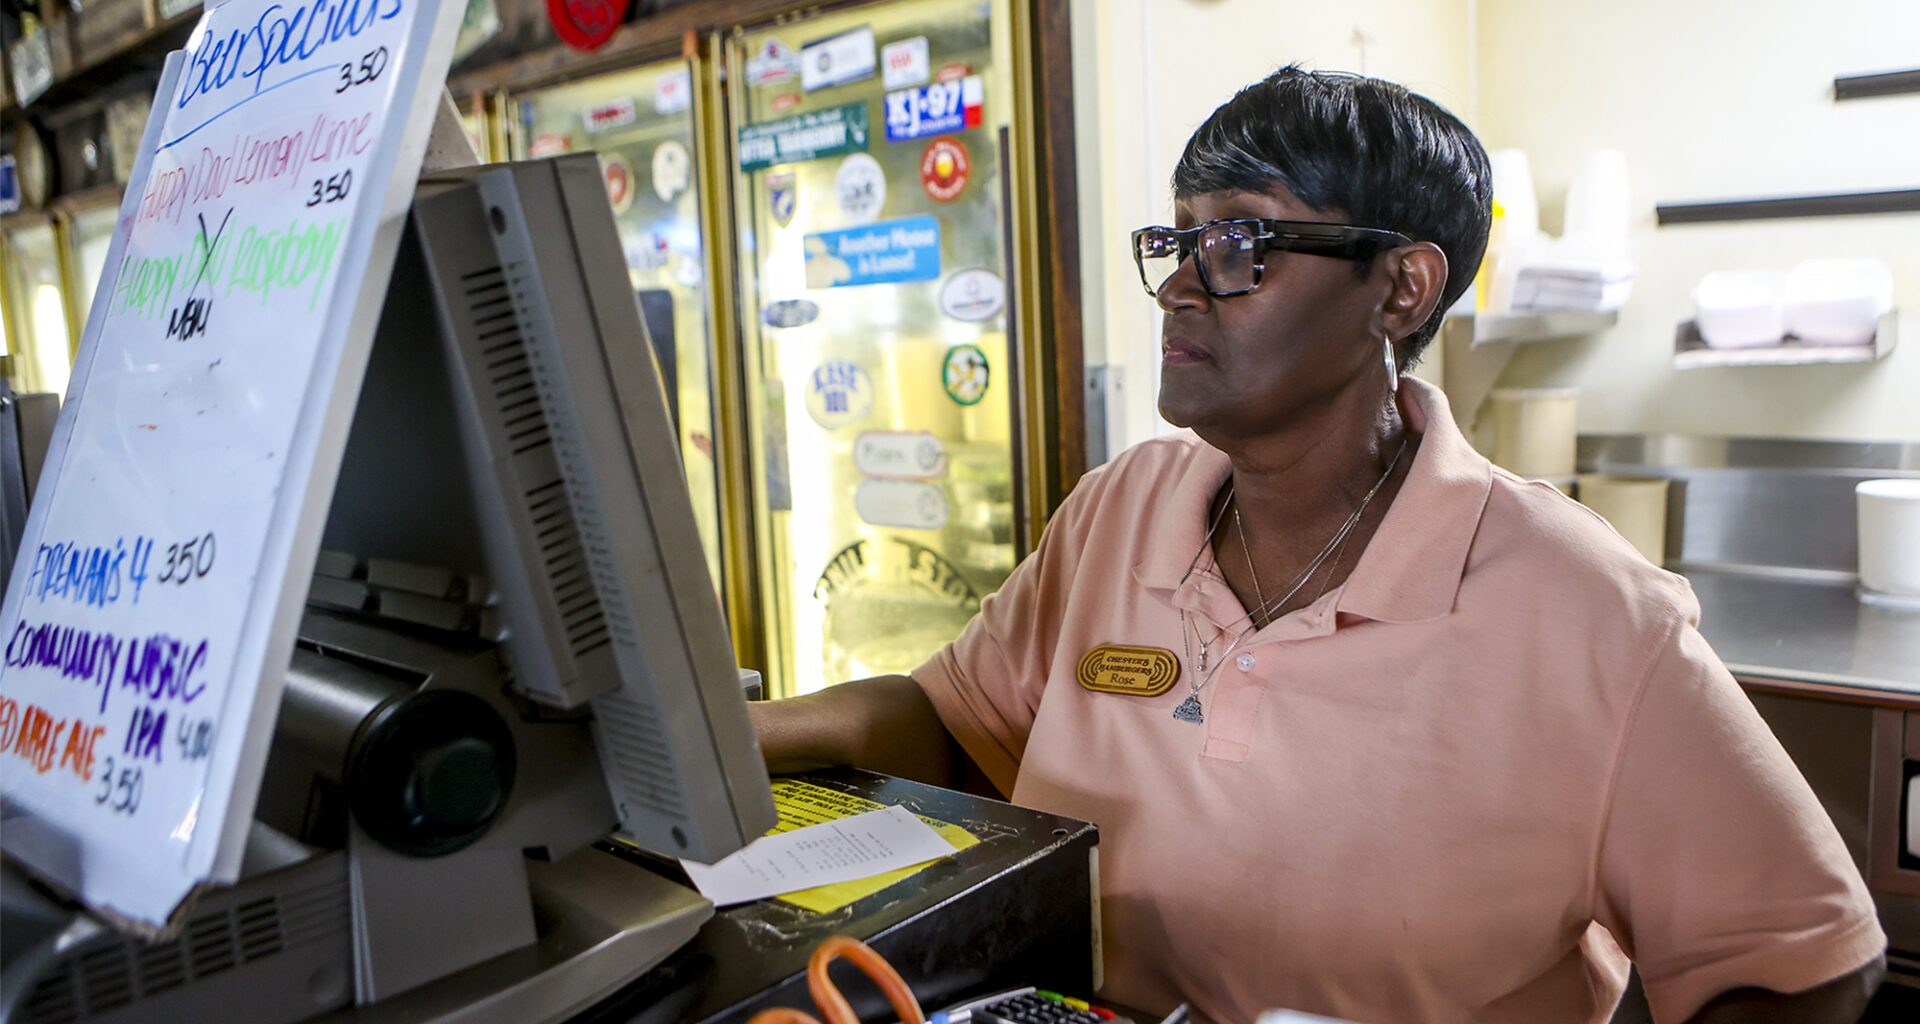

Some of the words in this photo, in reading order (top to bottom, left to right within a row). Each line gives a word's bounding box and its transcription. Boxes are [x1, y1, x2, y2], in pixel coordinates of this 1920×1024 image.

[179, 28, 249, 109] Beer
[890, 227, 937, 249] Moose
[109, 253, 183, 321] Happy
[130, 535, 154, 605] 4
[1098, 664, 1153, 676] HAMBURGERS
[1110, 673, 1136, 685] Rose
[123, 706, 168, 773] IPA
